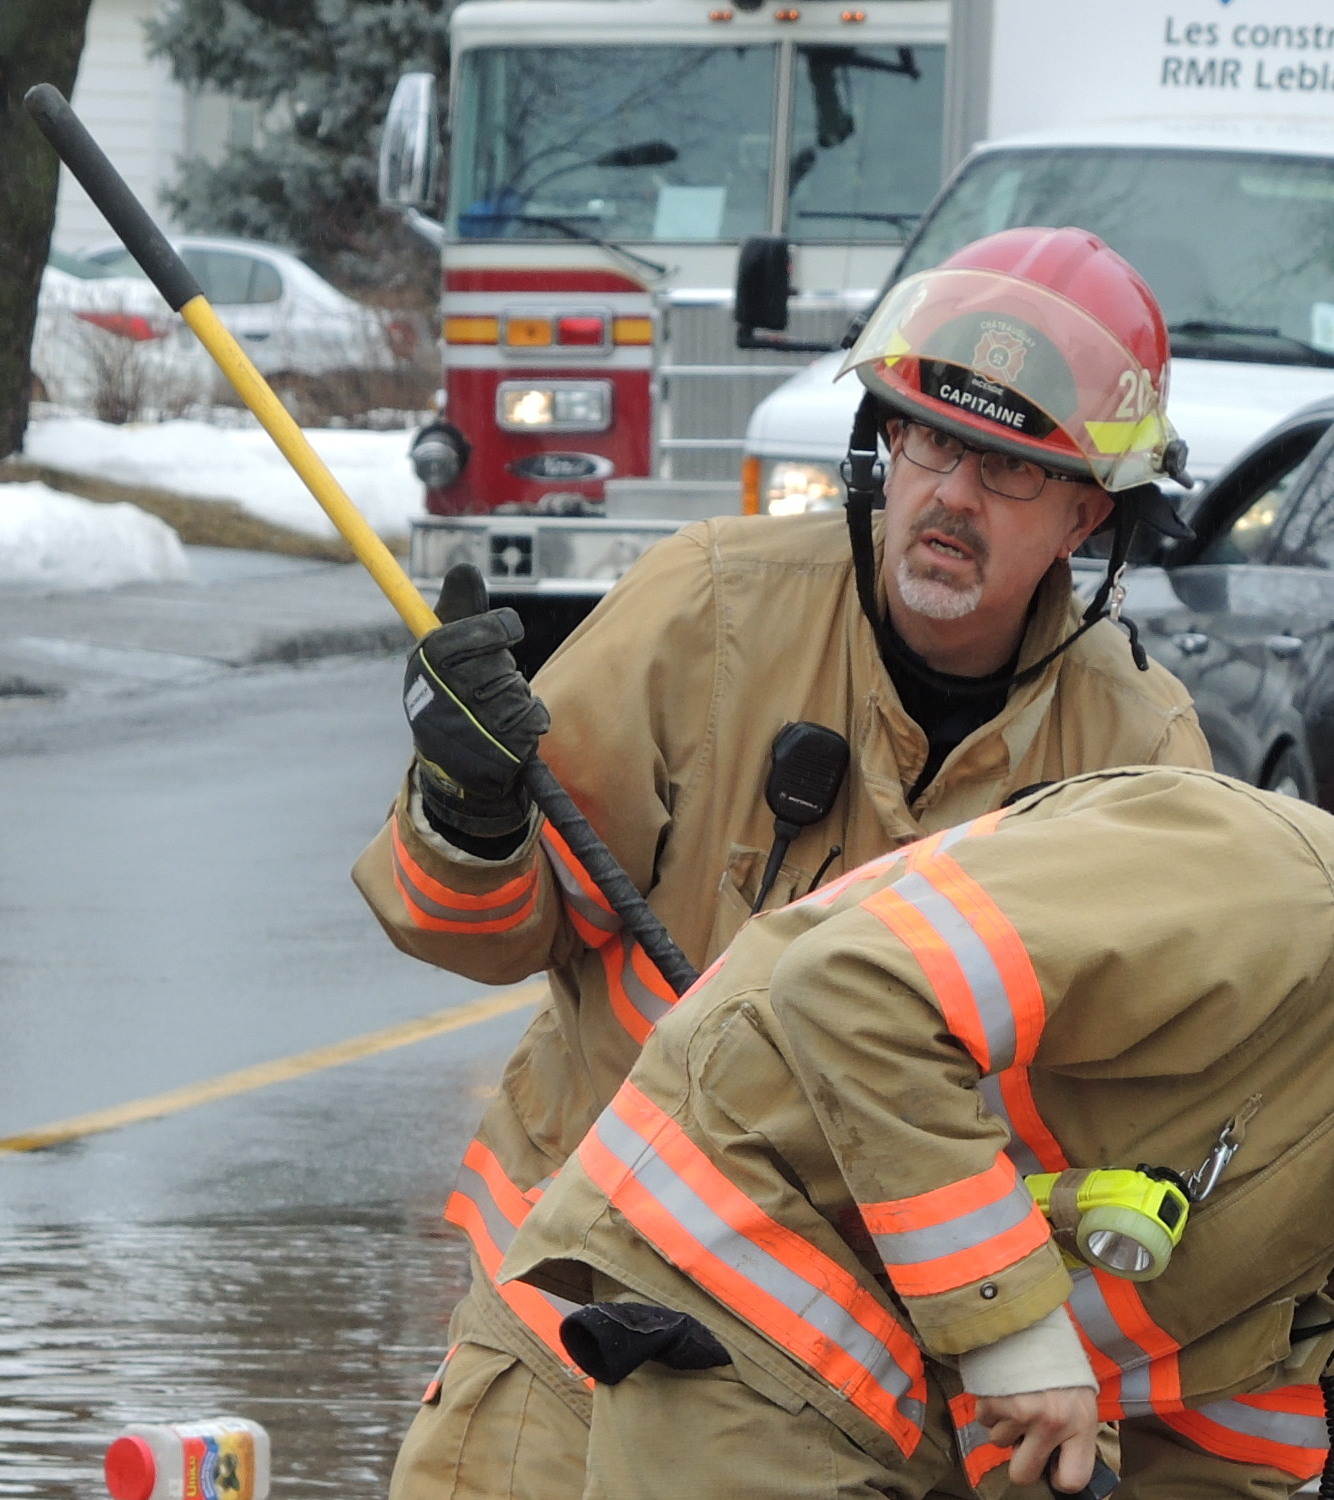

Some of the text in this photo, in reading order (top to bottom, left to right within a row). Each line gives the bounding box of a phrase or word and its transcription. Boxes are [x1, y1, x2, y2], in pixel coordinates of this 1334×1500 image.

[1164, 16, 1220, 46] Les
[1161, 56, 1242, 88] RMR
[939, 384, 1026, 428] CAPITAINE
